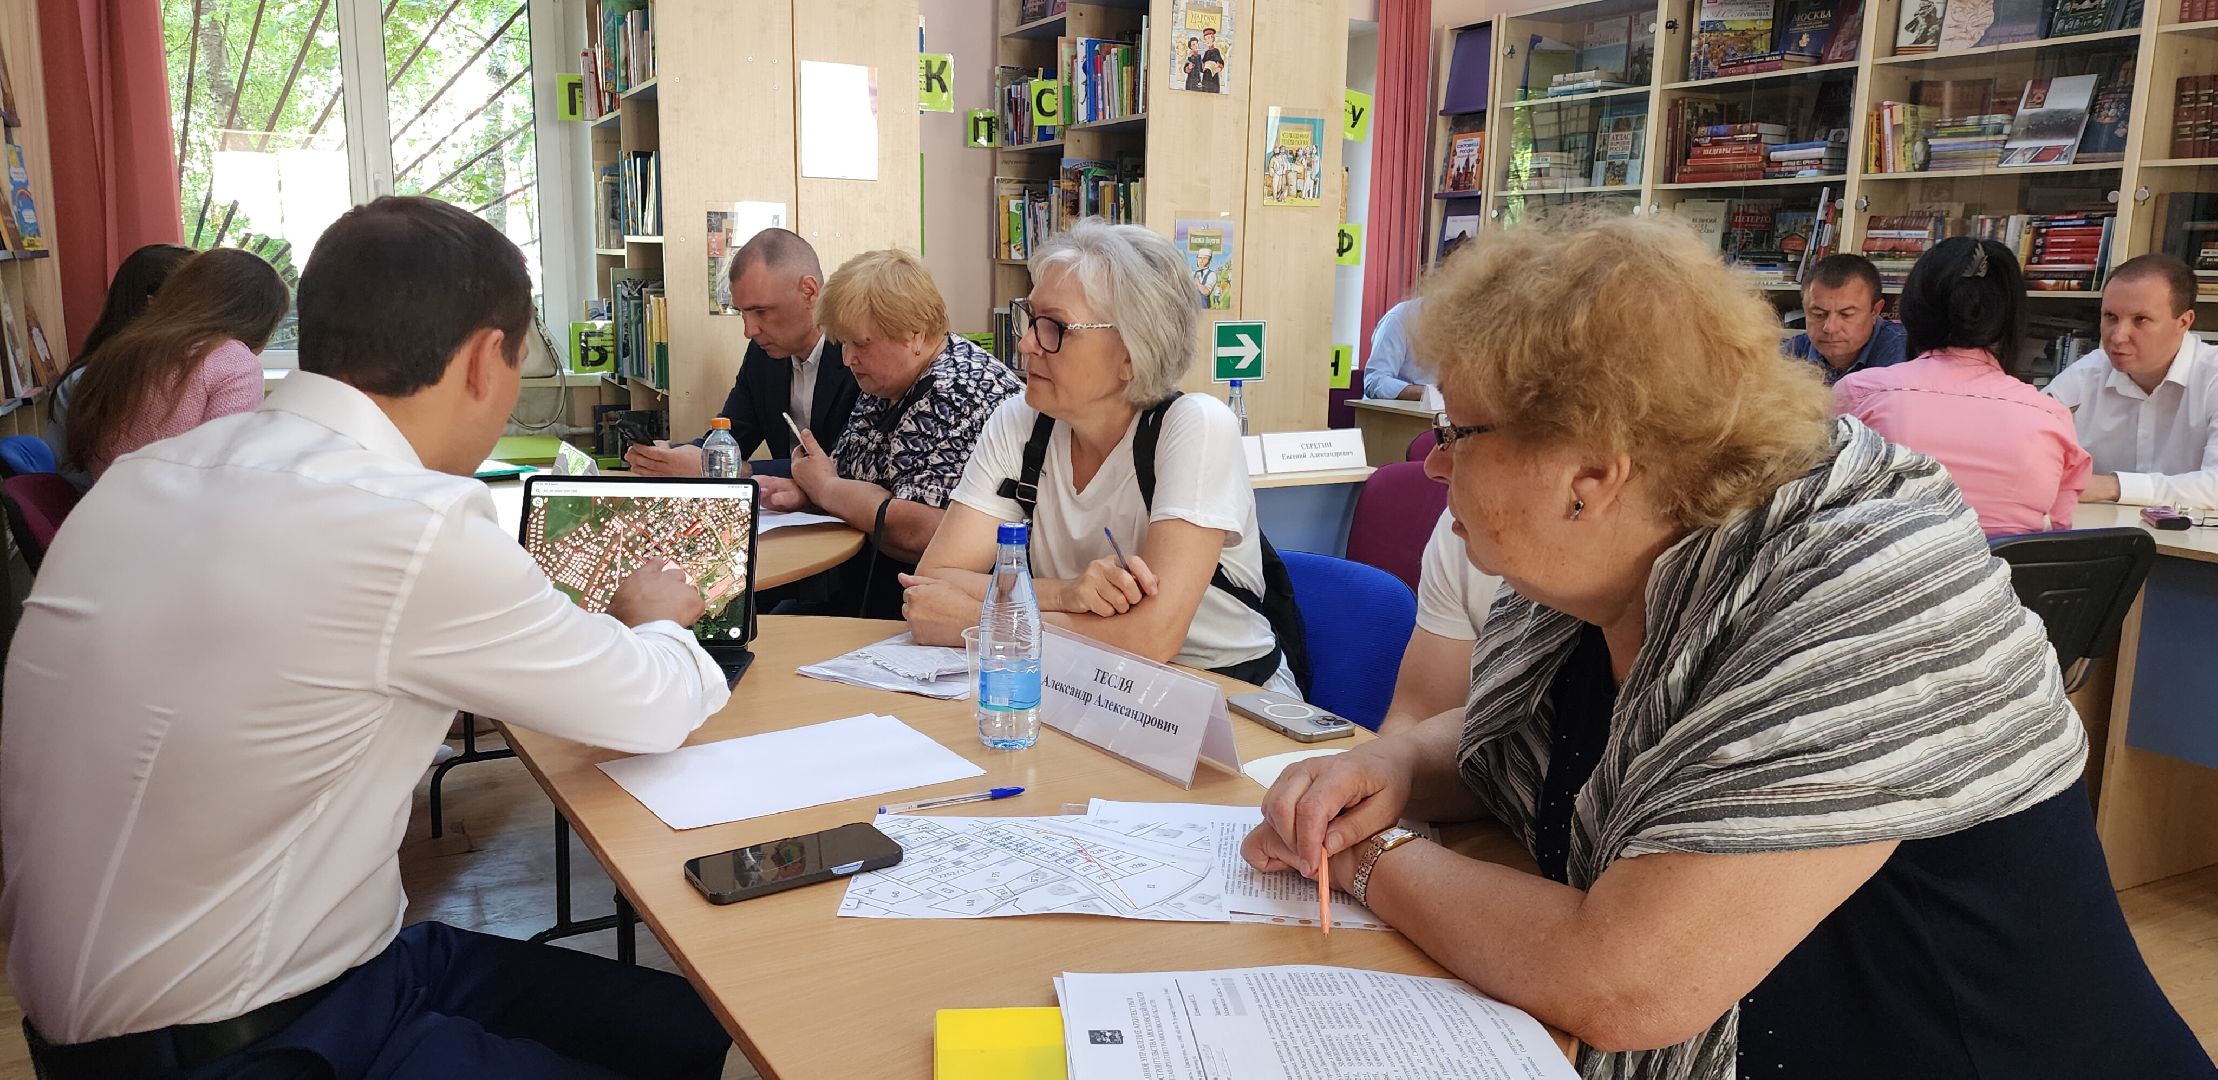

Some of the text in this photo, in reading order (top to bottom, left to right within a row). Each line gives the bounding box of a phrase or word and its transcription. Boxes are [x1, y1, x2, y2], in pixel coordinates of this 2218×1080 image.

[1791, 9, 1832, 22] МОСКВА
[925, 60, 948, 93] К
[1035, 88, 1057, 117] С
[1350, 104, 1365, 129] У
[1734, 214, 1772, 224] ПЕТЕРГО
[579, 331, 609, 367] Б
[1281, 450, 1354, 461] Евгений Александрович
[1300, 441, 1332, 450] СЕРЕГИН
[1092, 667, 1135, 694] ТЕСЛЯ
[1041, 674, 1179, 736] Александр Александрович
